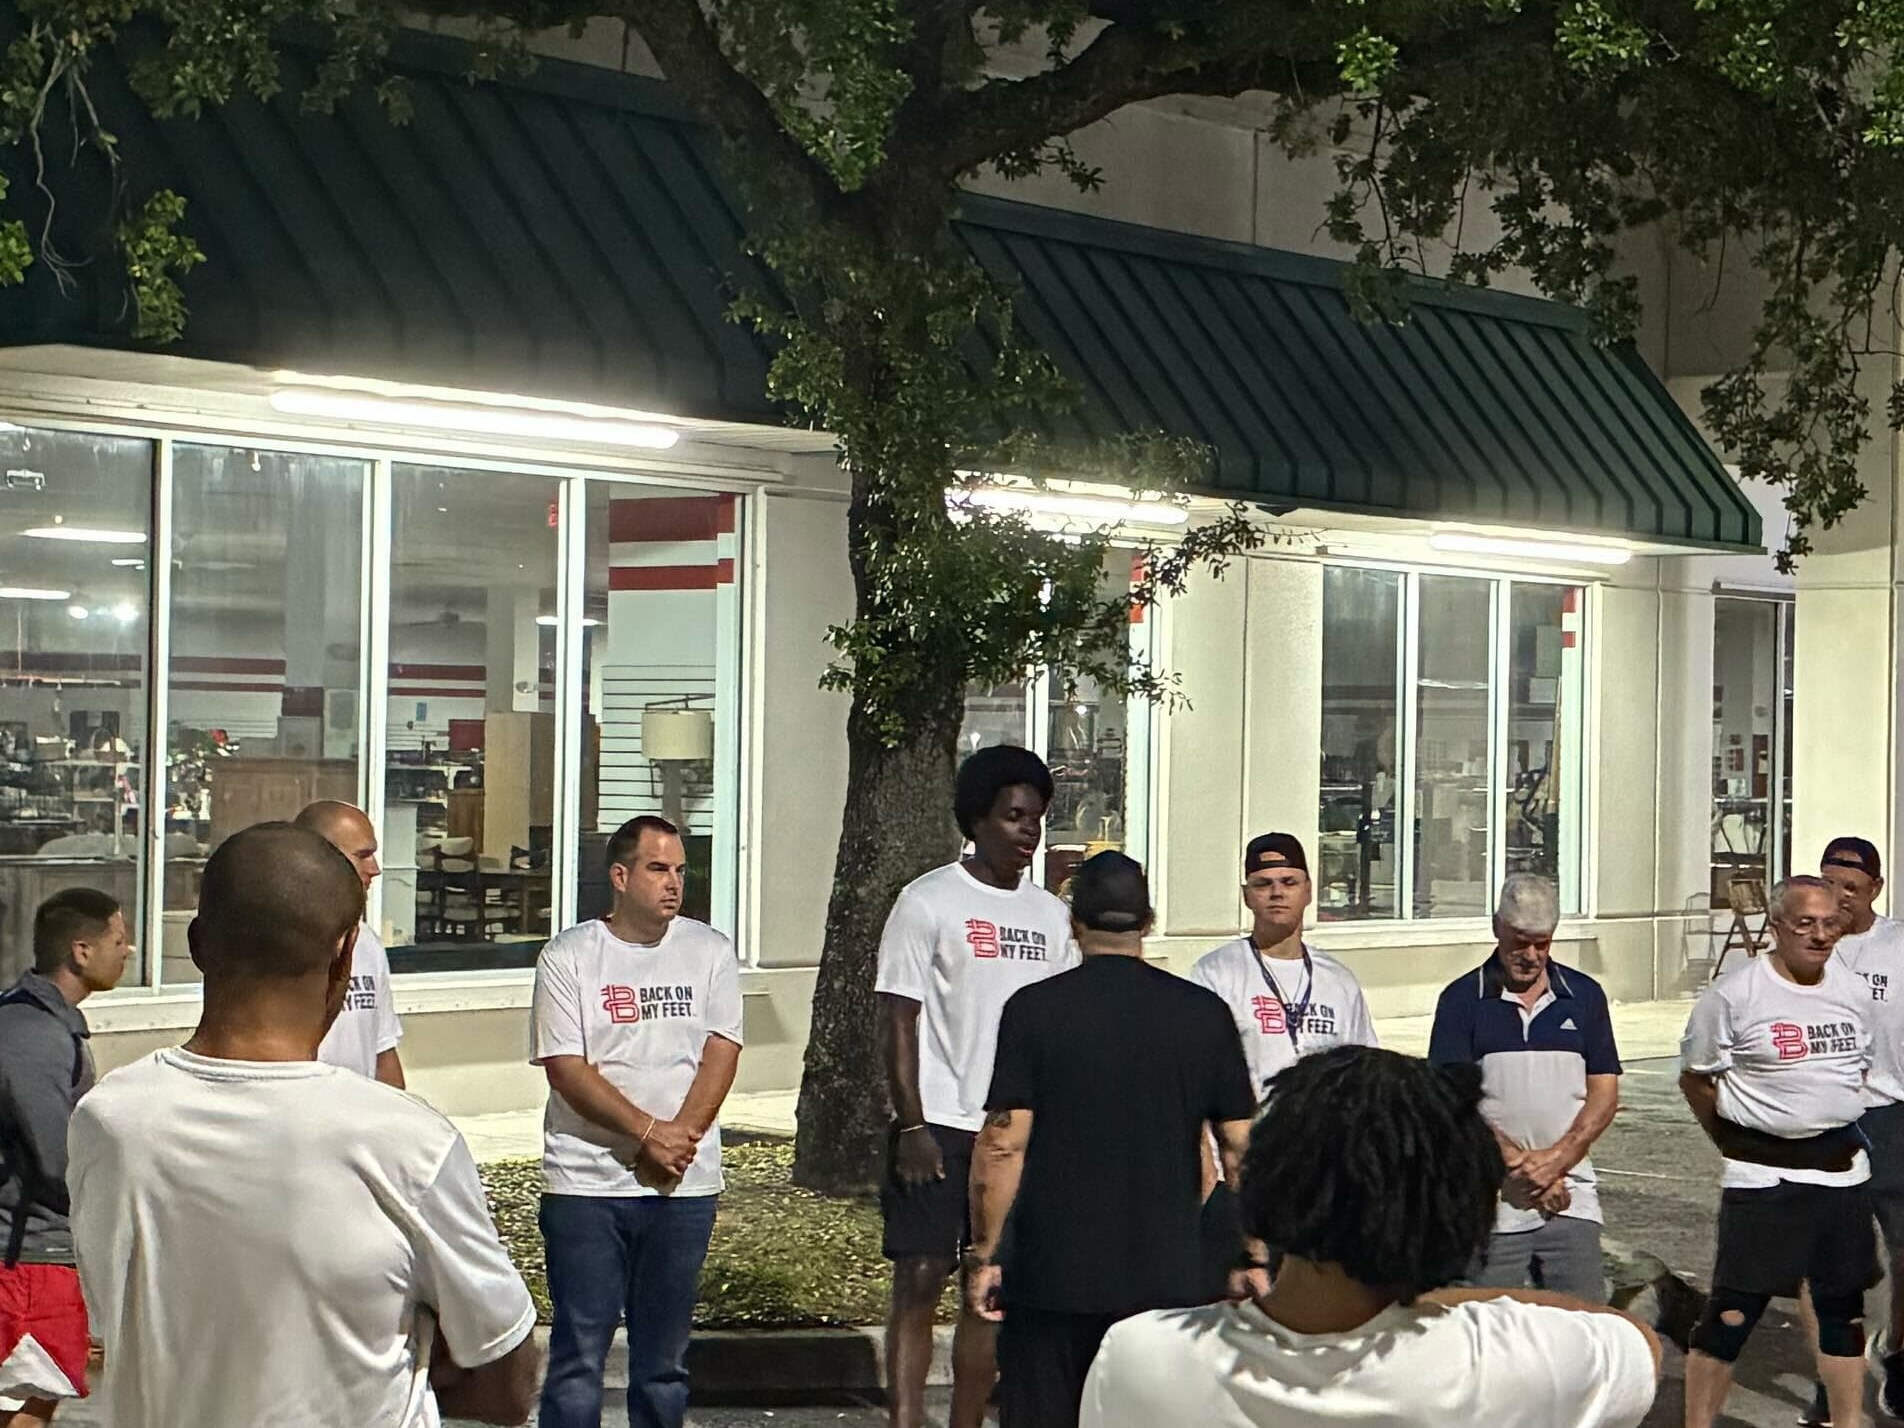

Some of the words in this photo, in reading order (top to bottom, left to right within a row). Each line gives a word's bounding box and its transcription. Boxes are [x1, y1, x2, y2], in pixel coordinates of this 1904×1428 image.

[999, 926, 1030, 942] BACK
[639, 986, 673, 1003] BACK
[674, 985, 693, 1001] ON
[641, 1003, 659, 1021] MY
[1807, 1023, 1840, 1040] BACK
[1840, 1022, 1856, 1036] ON
[1809, 1040, 1827, 1054] MY
